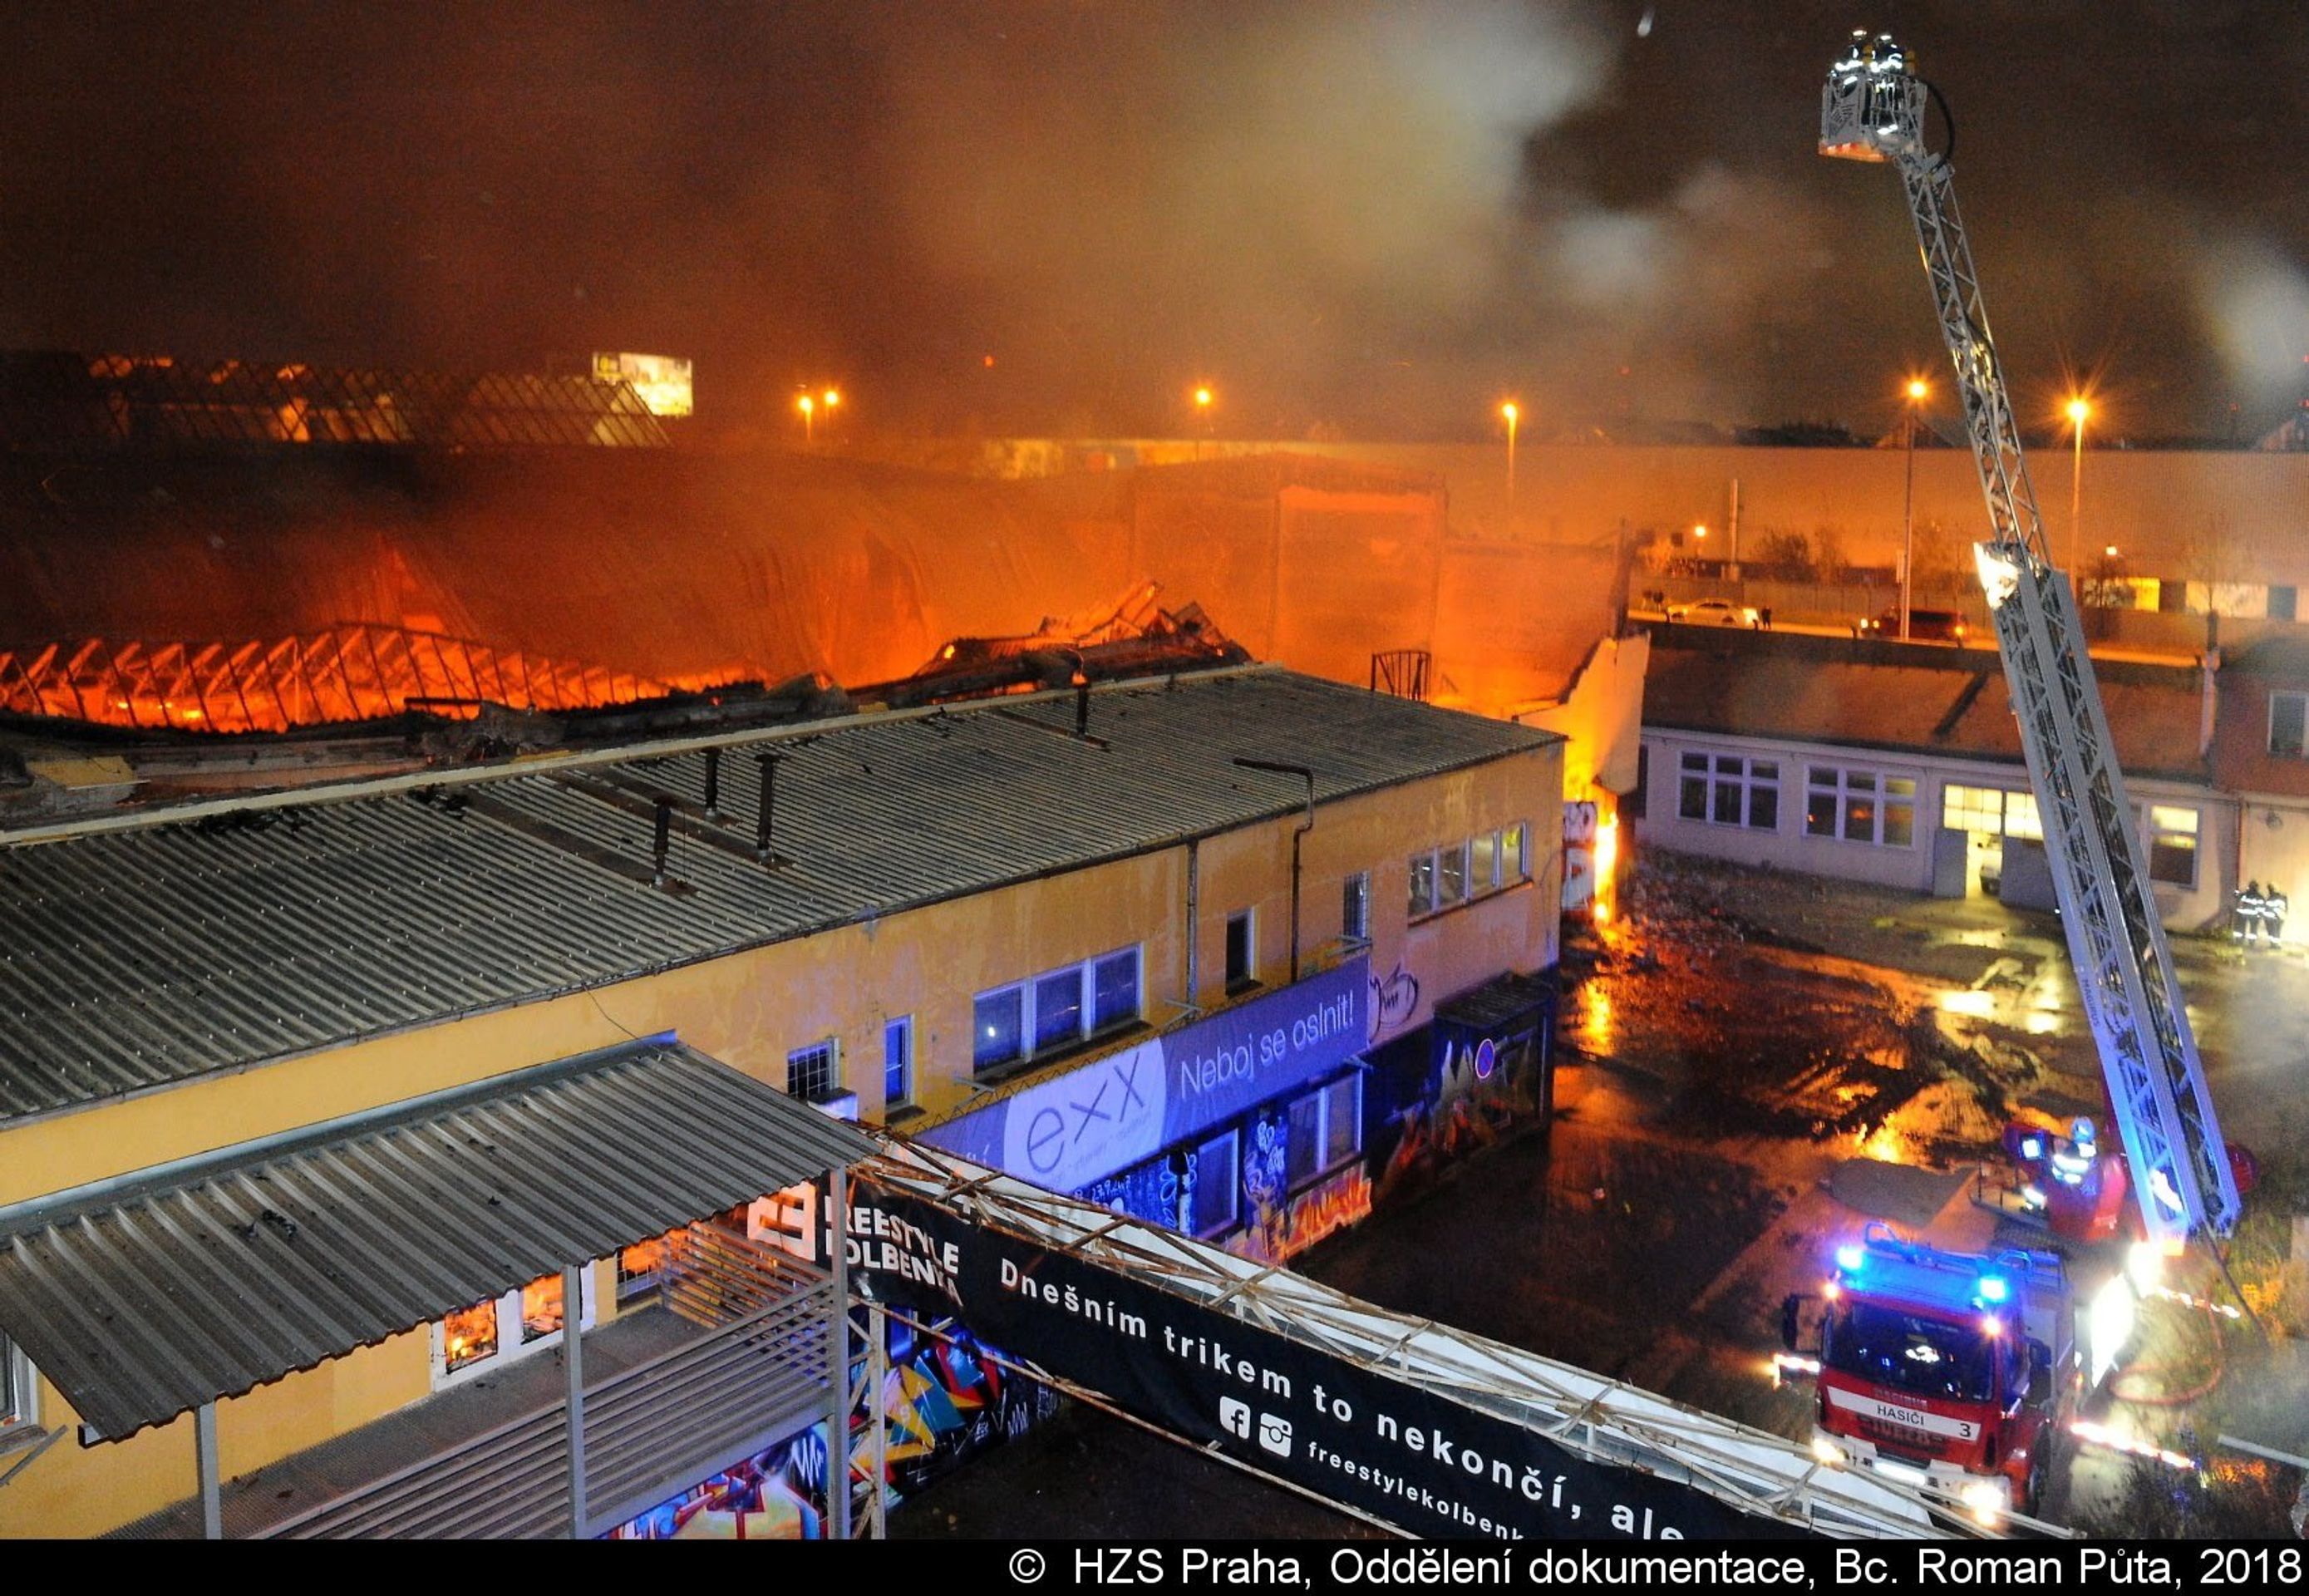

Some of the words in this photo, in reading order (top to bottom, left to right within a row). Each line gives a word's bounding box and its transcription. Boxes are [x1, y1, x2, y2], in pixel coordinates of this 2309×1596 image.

[1180, 1033, 1254, 1099] Neboj
[1259, 1028, 1286, 1066] se
[1292, 989, 1354, 1051] oslnit!
[1026, 1051, 1145, 1174] exx
[1001, 1257, 1147, 1338] Dnešním
[1164, 1325, 1292, 1399] trikem
[1312, 1384, 1352, 1422] to
[1376, 1413, 1581, 1520] nekončí,
[1876, 1404, 1925, 1426] HASIČI
[1958, 1422, 1972, 1438] 3
